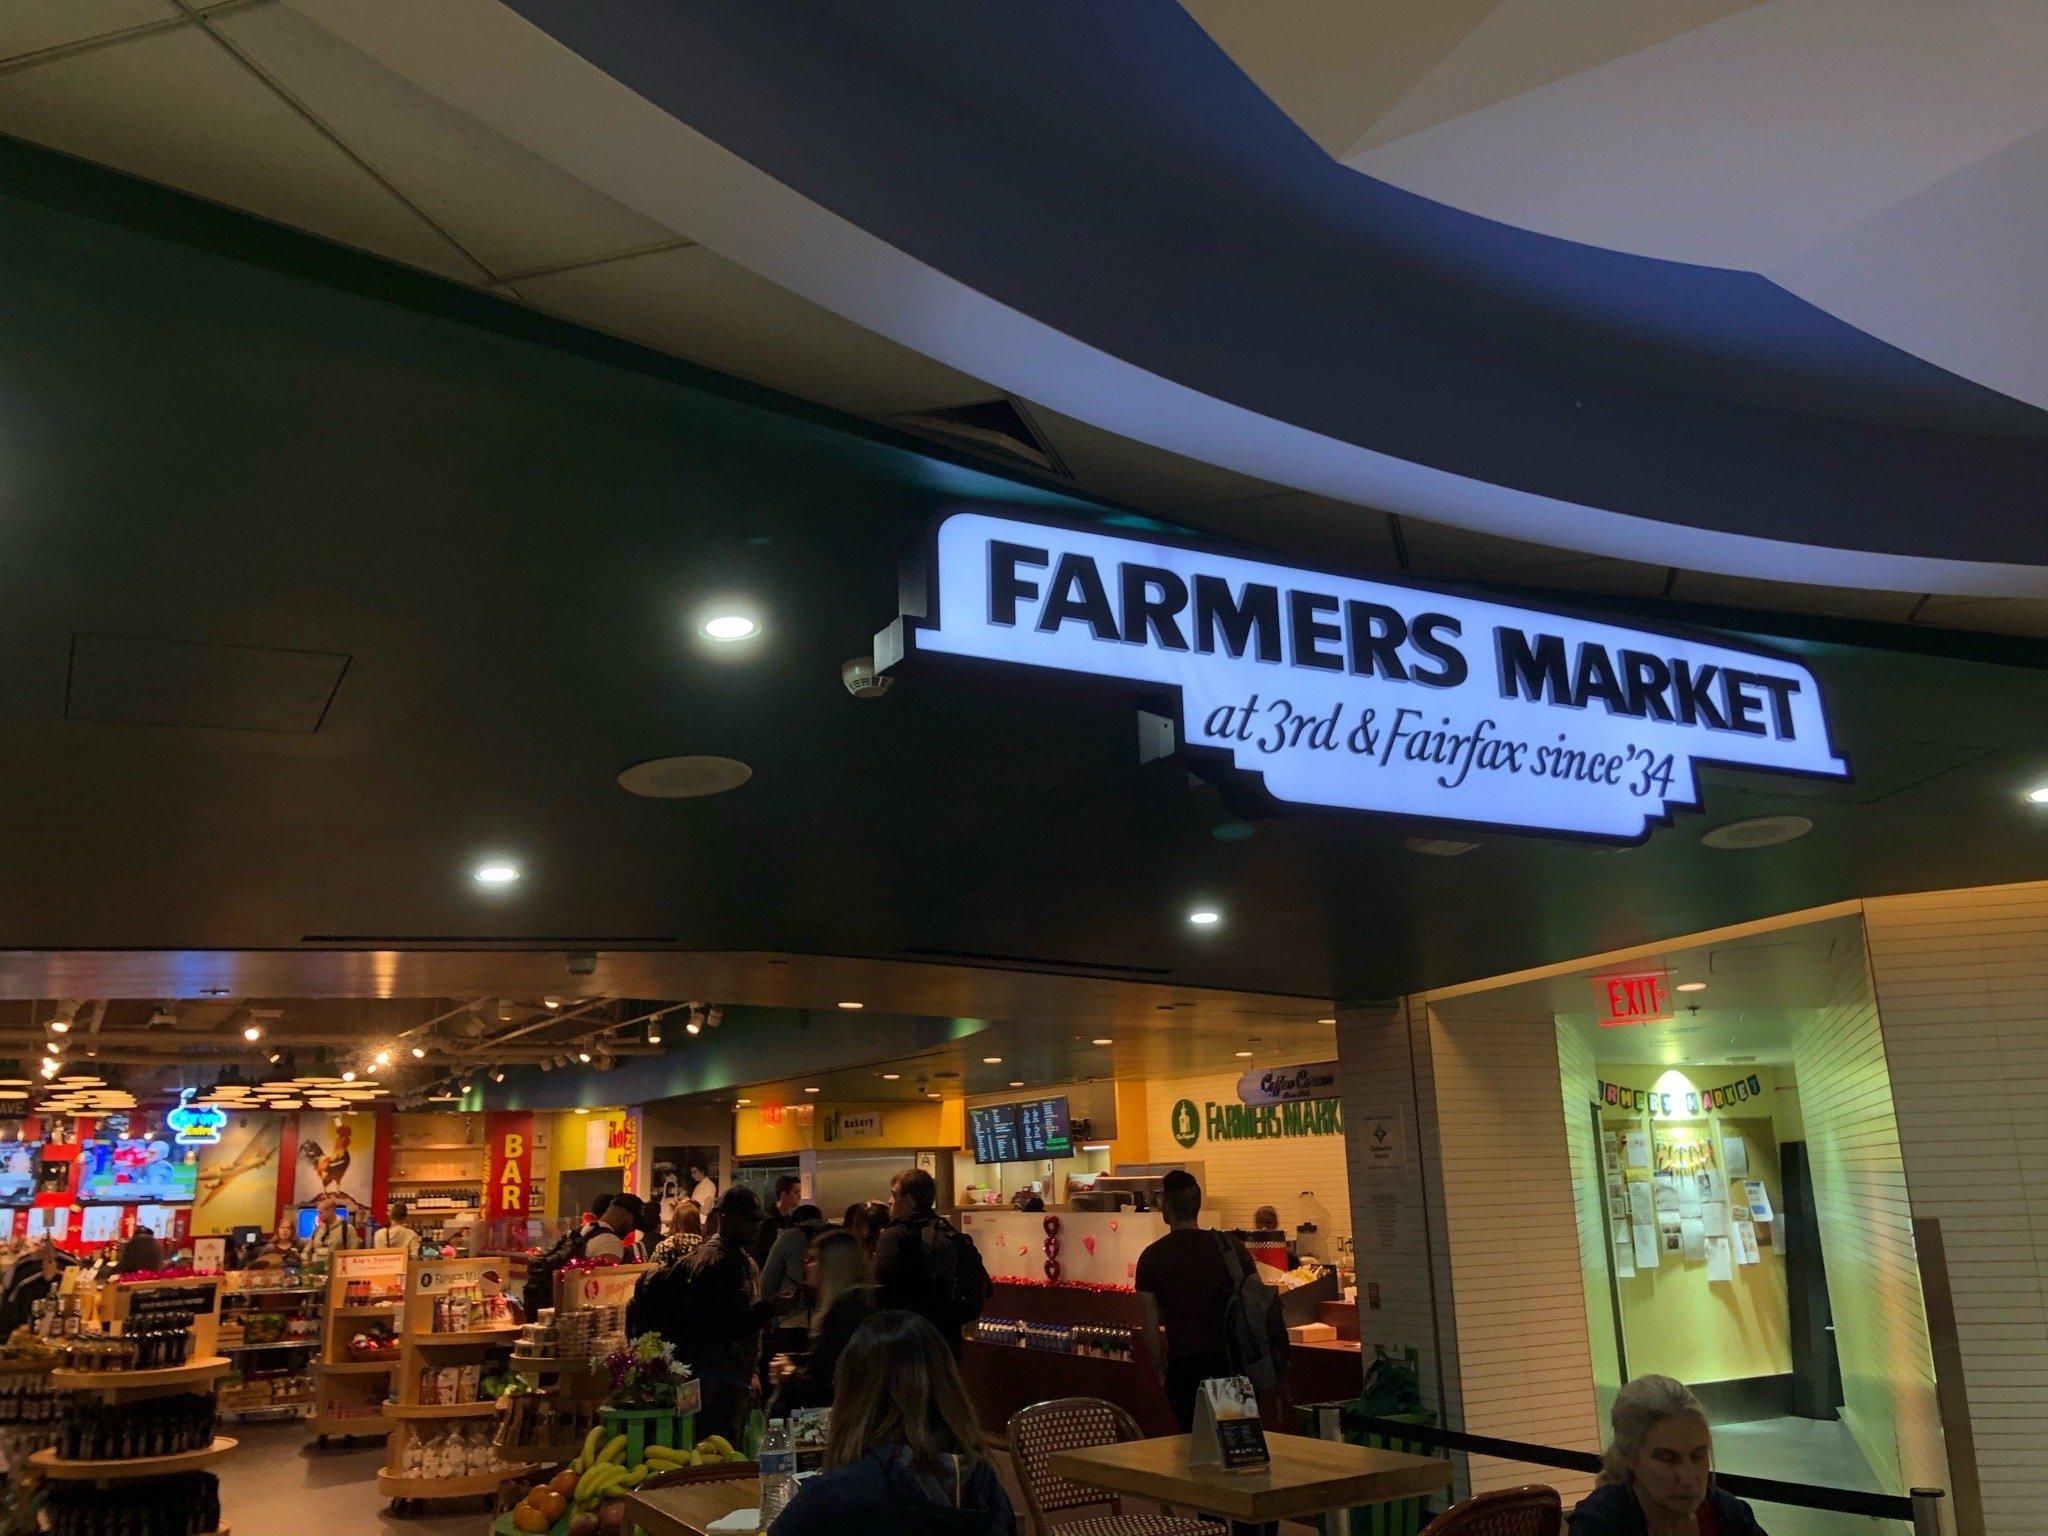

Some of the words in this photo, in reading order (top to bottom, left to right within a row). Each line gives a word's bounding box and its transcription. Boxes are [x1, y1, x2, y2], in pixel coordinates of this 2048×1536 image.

[985, 538, 1469, 690] FARMERS
[1492, 625, 1801, 743] MARKET
[1202, 694, 1259, 741] at
[1256, 699, 1345, 754] 3rd
[1347, 707, 1380, 756] &
[1378, 707, 1529, 789] Fairfax
[1529, 733, 1624, 786] since
[1607, 976, 1659, 1018] EXIT
[1205, 1101, 1282, 1142] FARMERS
[1282, 1098, 1344, 1138] MARK
[499, 1133, 524, 1210] BAR
